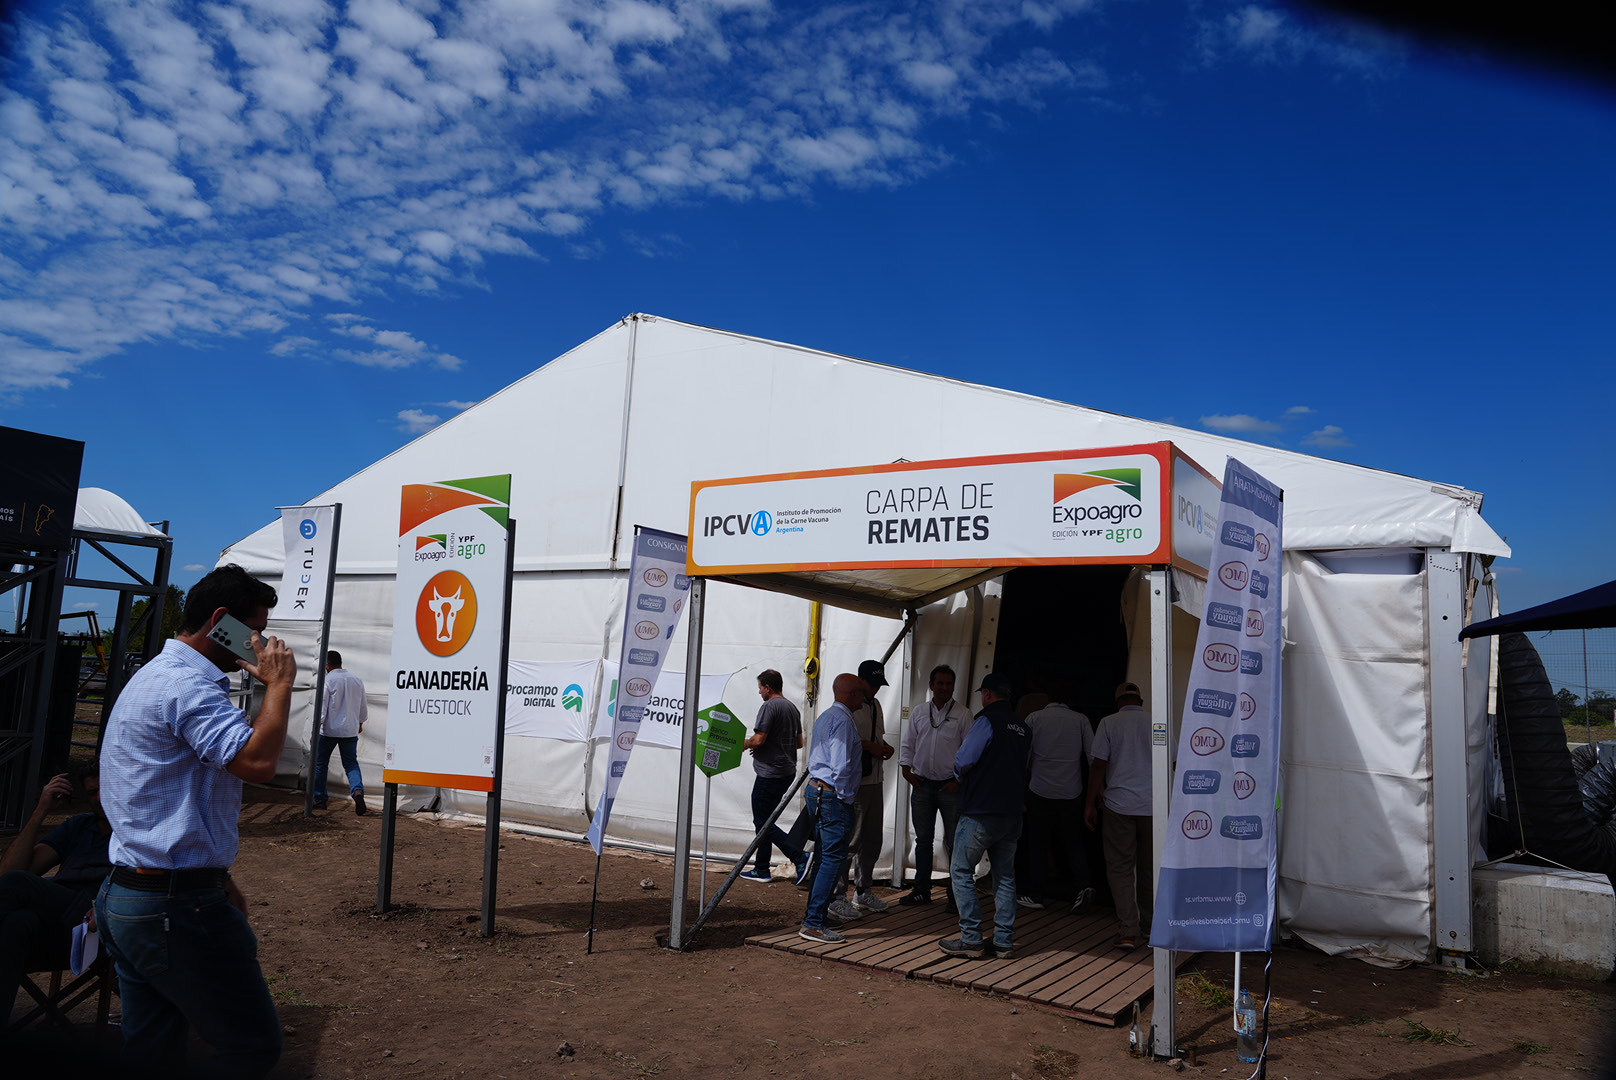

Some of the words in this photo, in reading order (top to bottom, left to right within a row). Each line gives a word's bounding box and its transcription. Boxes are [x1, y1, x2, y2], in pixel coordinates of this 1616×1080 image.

[866, 485, 949, 515] CARPA
[961, 482, 994, 510] DE
[801, 508, 809, 516] de
[809, 506, 842, 515] Promoción
[1053, 503, 1143, 526] Expoagro
[1178, 495, 1203, 534] IPCVA
[703, 510, 773, 537] IPCVA
[783, 517, 790, 525] la
[790, 517, 807, 525] Carne
[807, 516, 830, 524] Vacuna
[776, 526, 804, 534] Argentina
[867, 514, 990, 545] REMATES
[1052, 529, 1079, 538] EDICIÓN
[1081, 529, 1104, 537] YPF
[1105, 527, 1143, 544] agro
[458, 535, 476, 543] YPF
[414, 551, 447, 562] Expoagro
[457, 543, 487, 560] agro
[647, 572, 666, 583] UMC
[637, 625, 656, 636] UMC
[396, 666, 489, 691] GANADERÍA
[506, 684, 559, 697] Procampo
[628, 682, 649, 692] UMC
[408, 698, 472, 716] LIVESTOCK
[523, 697, 556, 708] DIGITAL
